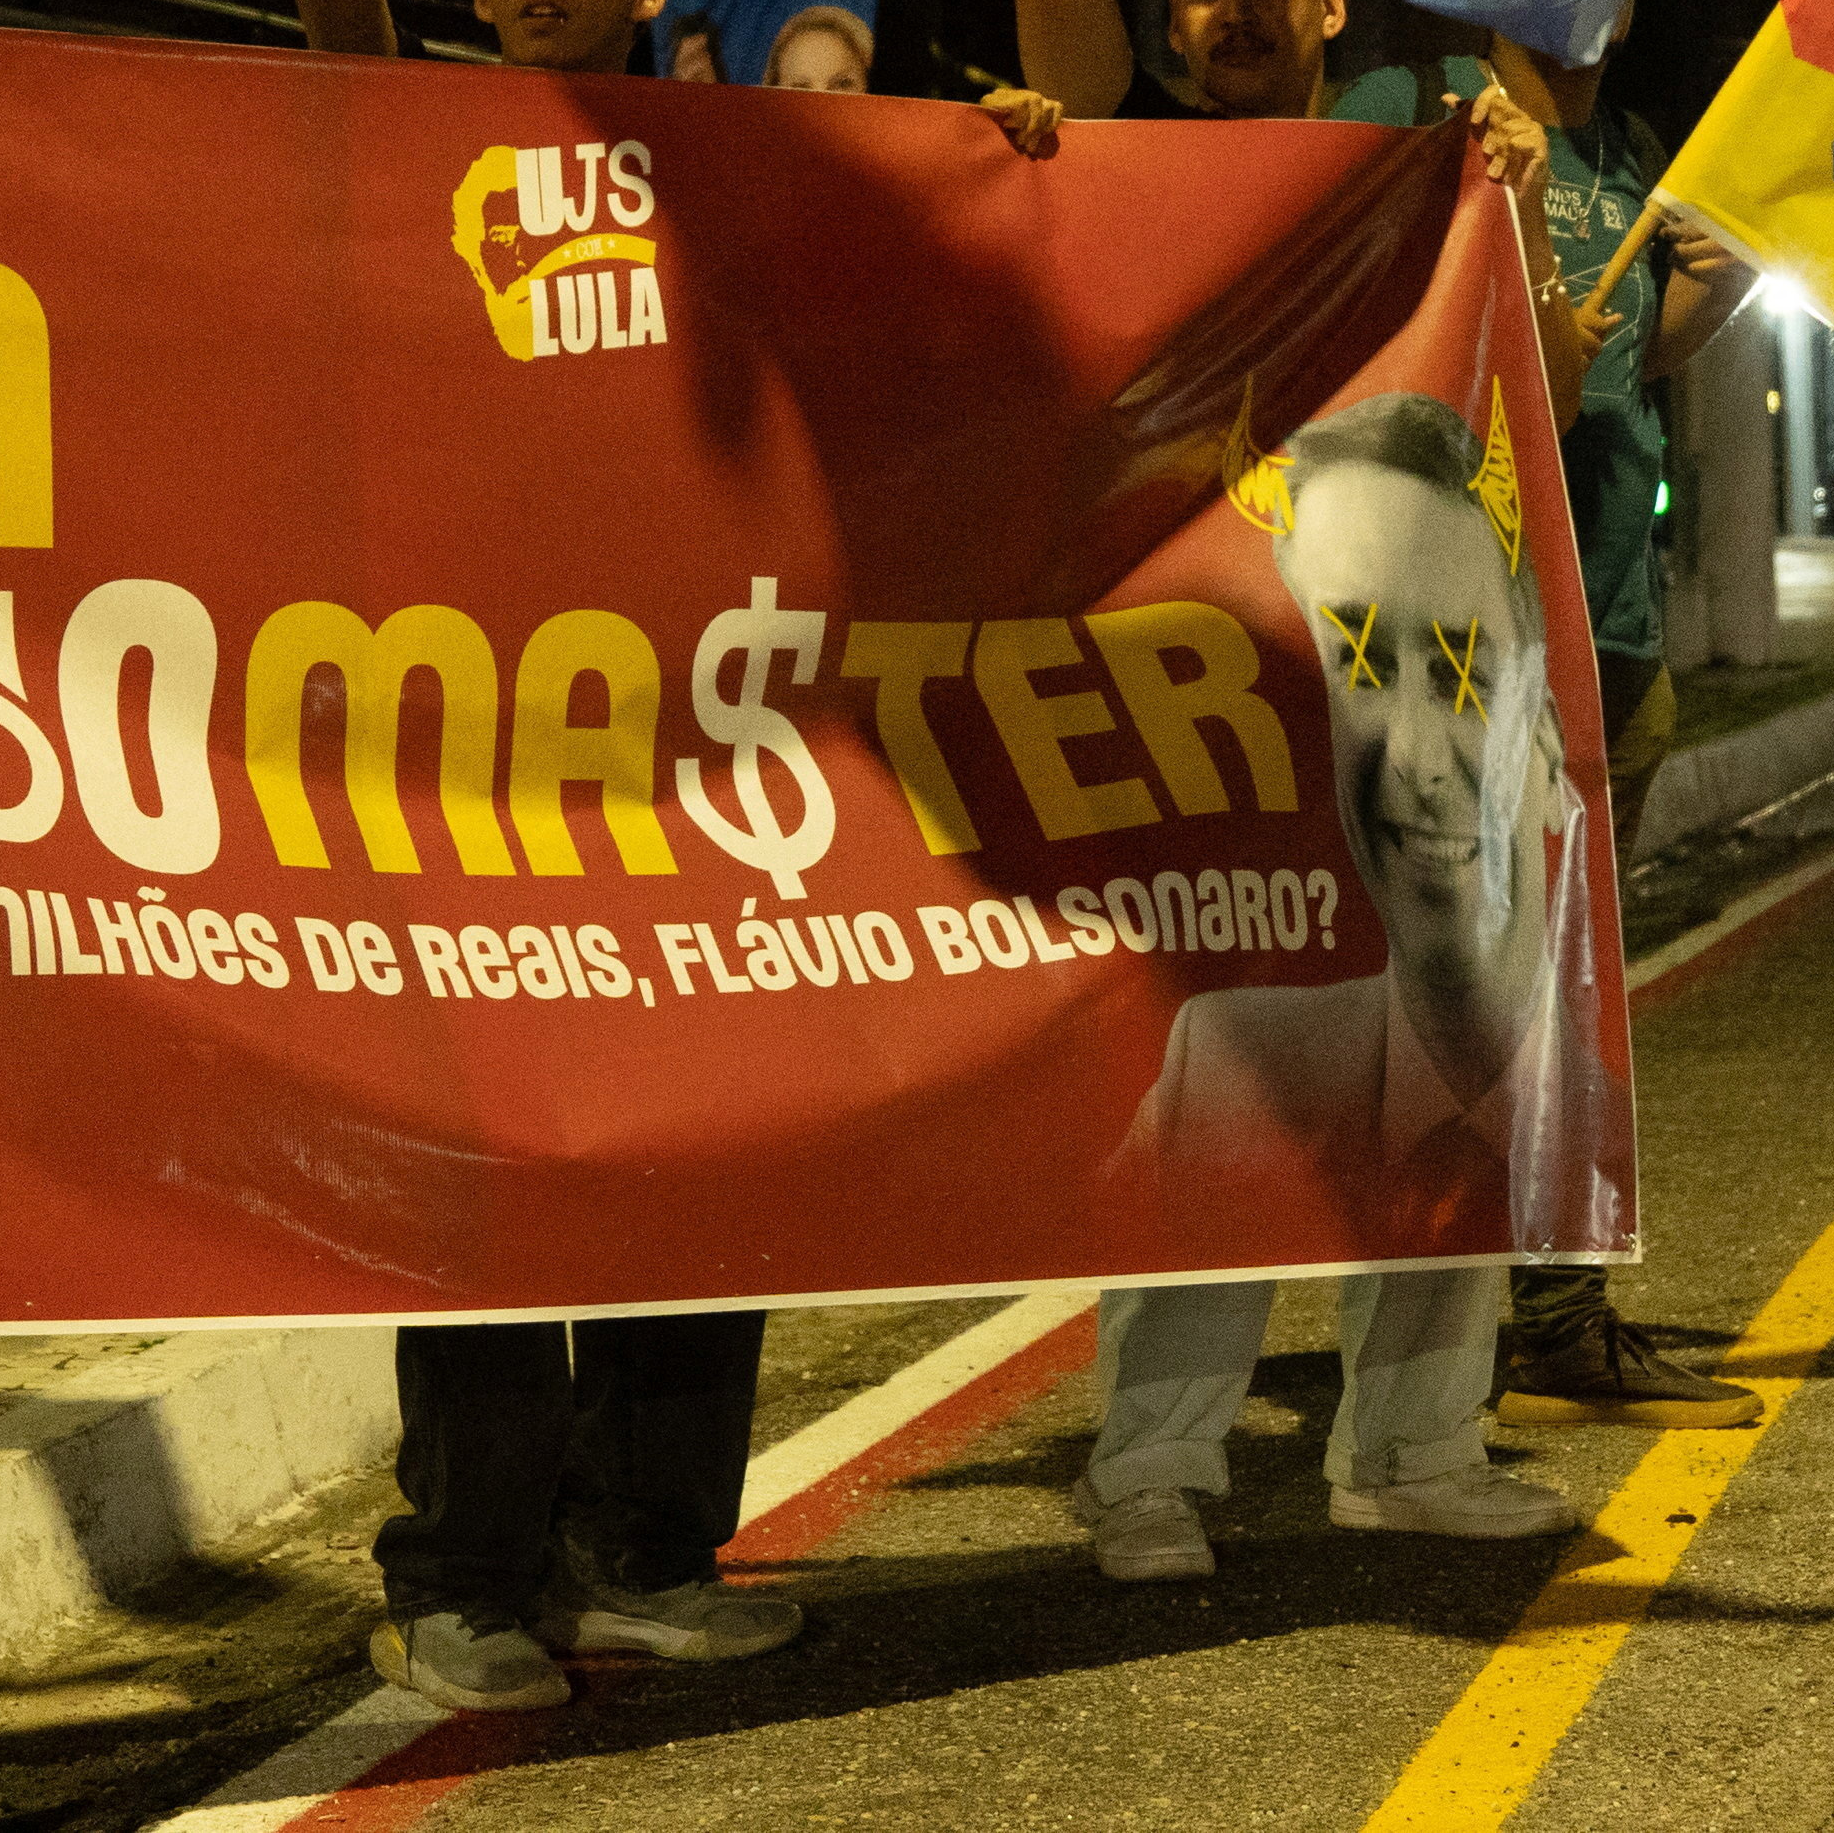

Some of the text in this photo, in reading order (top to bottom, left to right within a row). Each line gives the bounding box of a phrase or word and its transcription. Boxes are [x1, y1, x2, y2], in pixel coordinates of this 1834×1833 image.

[516, 139, 655, 236] UJS
[528, 267, 667, 358] LULA
[293, 915, 404, 998] DE
[408, 922, 655, 1008] REAIS,
[655, 896, 916, 996] FLÁVIO
[917, 867, 1339, 978] BOLSONARO?
